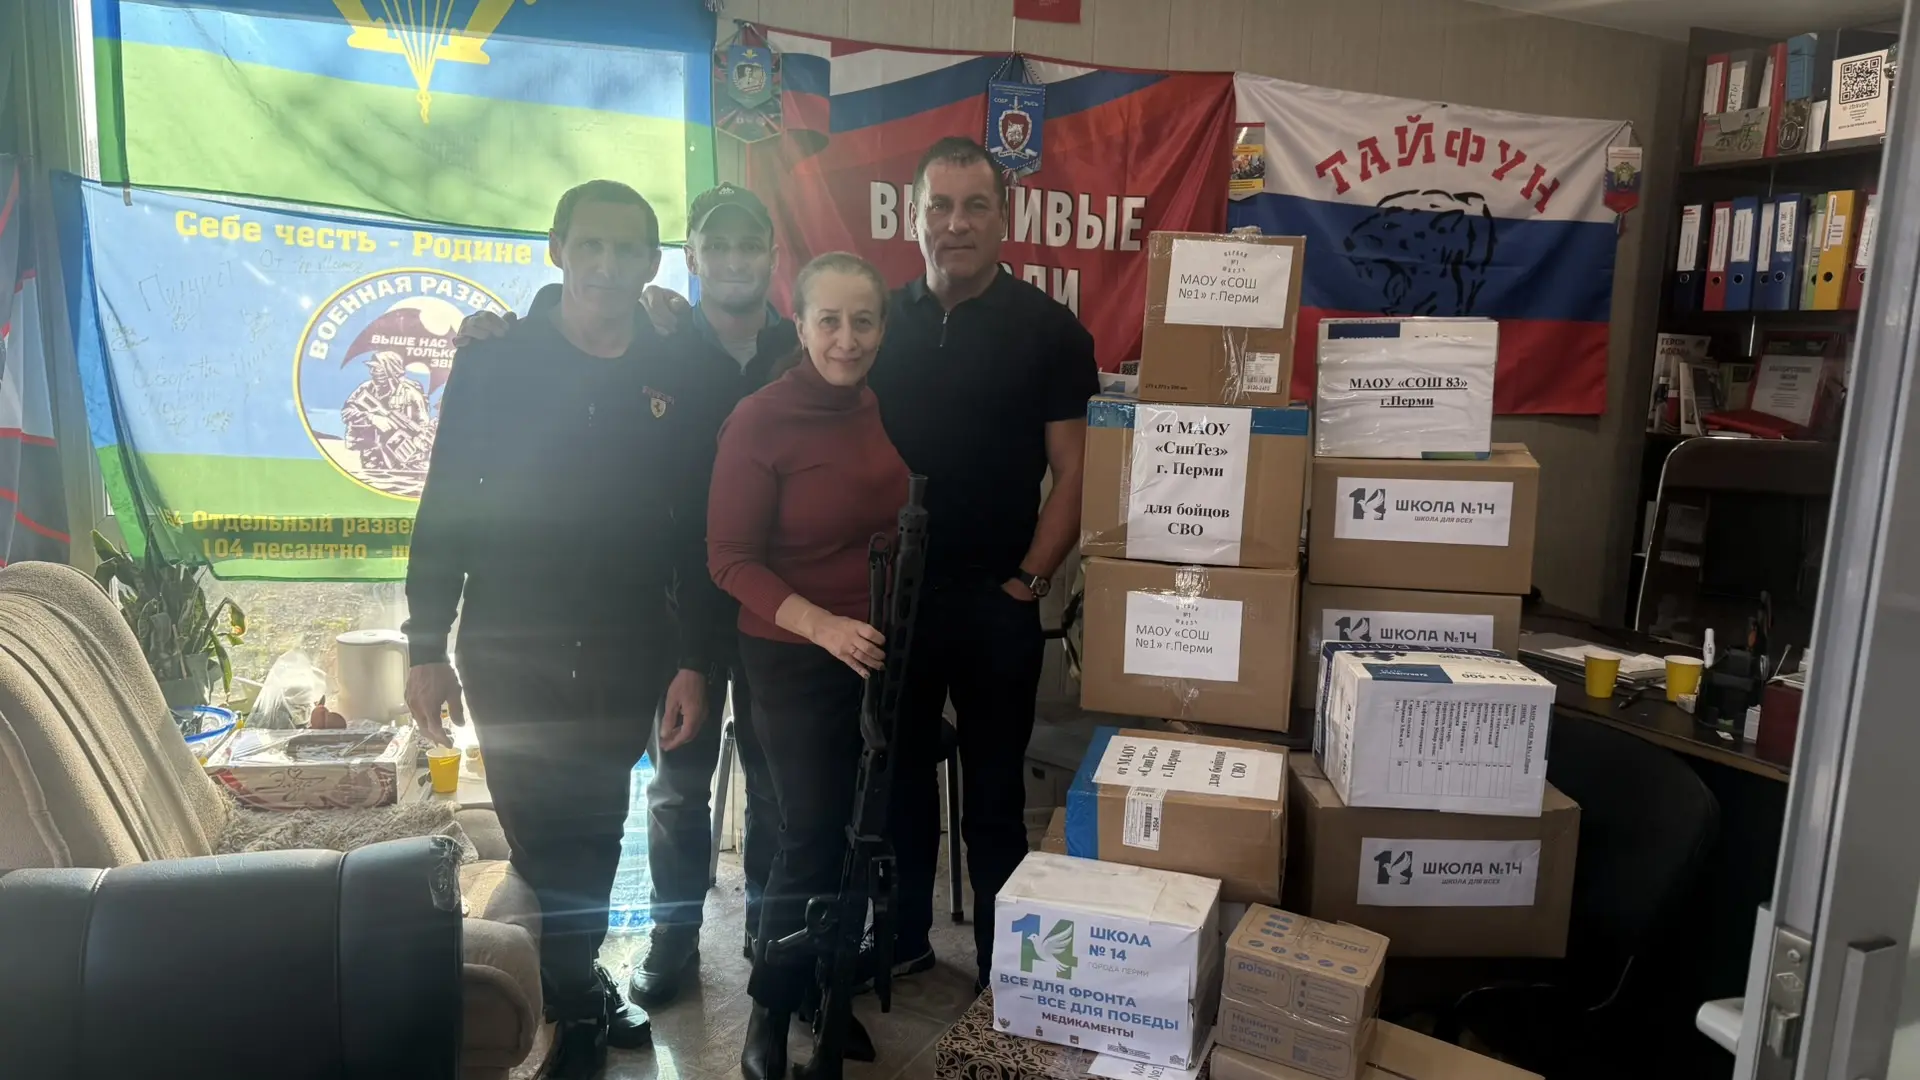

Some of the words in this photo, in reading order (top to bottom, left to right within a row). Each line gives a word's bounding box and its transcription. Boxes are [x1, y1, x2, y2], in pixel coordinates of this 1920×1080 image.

[1315, 114, 1560, 213] ТАЙФУН
[870, 181, 1146, 251] ВИВЫЕ
[175, 210, 261, 242] Себе
[275, 224, 377, 252] честь
[412, 231, 532, 264] Родине
[1180, 274, 1217, 286] МАОУ
[1221, 277, 1257, 289] «СОШ
[1179, 288, 1206, 299] №1»
[1210, 291, 1259, 304] г.Перми
[308, 275, 412, 361] ВОЕННАЯ
[420, 276, 506, 317] РАЗВЕ
[371, 335, 416, 346] ВЫШЕ
[419, 337, 447, 347] НАС
[1349, 378, 1395, 390] МАОУ
[1398, 377, 1442, 389] «СОШ
[1446, 377, 1468, 388] 83»
[1380, 396, 1434, 407] г.Перми
[1156, 423, 1172, 433] от
[1178, 421, 1230, 436] МАОУ
[1155, 441, 1228, 456] «СинТез»
[1157, 464, 1168, 474] г.
[1173, 462, 1224, 479] Перми
[1144, 504, 1172, 515] для
[1177, 503, 1230, 519] бойцов
[1396, 499, 1455, 513] ШКОЛА
[1461, 502, 1495, 515] №14
[192, 510, 334, 534] Отдельный
[342, 515, 414, 537] разве
[1168, 522, 1203, 536] СВО
[202, 538, 243, 559] 104
[253, 542, 367, 560] десантно
[1136, 625, 1171, 636] МАОУ
[1175, 629, 1209, 640] «СОШ
[1380, 627, 1439, 642] ШКОЛА
[1444, 630, 1477, 643] №14
[1136, 638, 1162, 648] №1»
[1166, 641, 1213, 654] г.Перми
[1117, 744, 1137, 766] МАОУ
[1137, 746, 1159, 777] «СинТез»
[1162, 749, 1181, 771] Перми
[1209, 751, 1226, 773] бойцов
[1117, 767, 1129, 776] от
[1231, 762, 1248, 779] СВО
[1208, 774, 1221, 787] для
[1423, 862, 1483, 874] ШКОЛА
[1489, 862, 1522, 874] №14
[1090, 926, 1152, 948] ШКОЛА
[1089, 944, 1105, 957] №
[1110, 948, 1127, 961] 14
[1088, 962, 1119, 973] ГОРОДА
[1122, 967, 1149, 978] ПЕРМИ
[1000, 974, 1029, 987] ВСЕ
[1033, 979, 1064, 995] ДЛЯ
[1069, 986, 1136, 1008] ФРОНТА
[1037, 995, 1067, 1010] ВСЕ
[1070, 1001, 1103, 1018] ДЛЯ
[1108, 1009, 1179, 1031] ПОБЕДЫ
[1042, 1012, 1134, 1038] МЕДИКАМЕНТЫ
